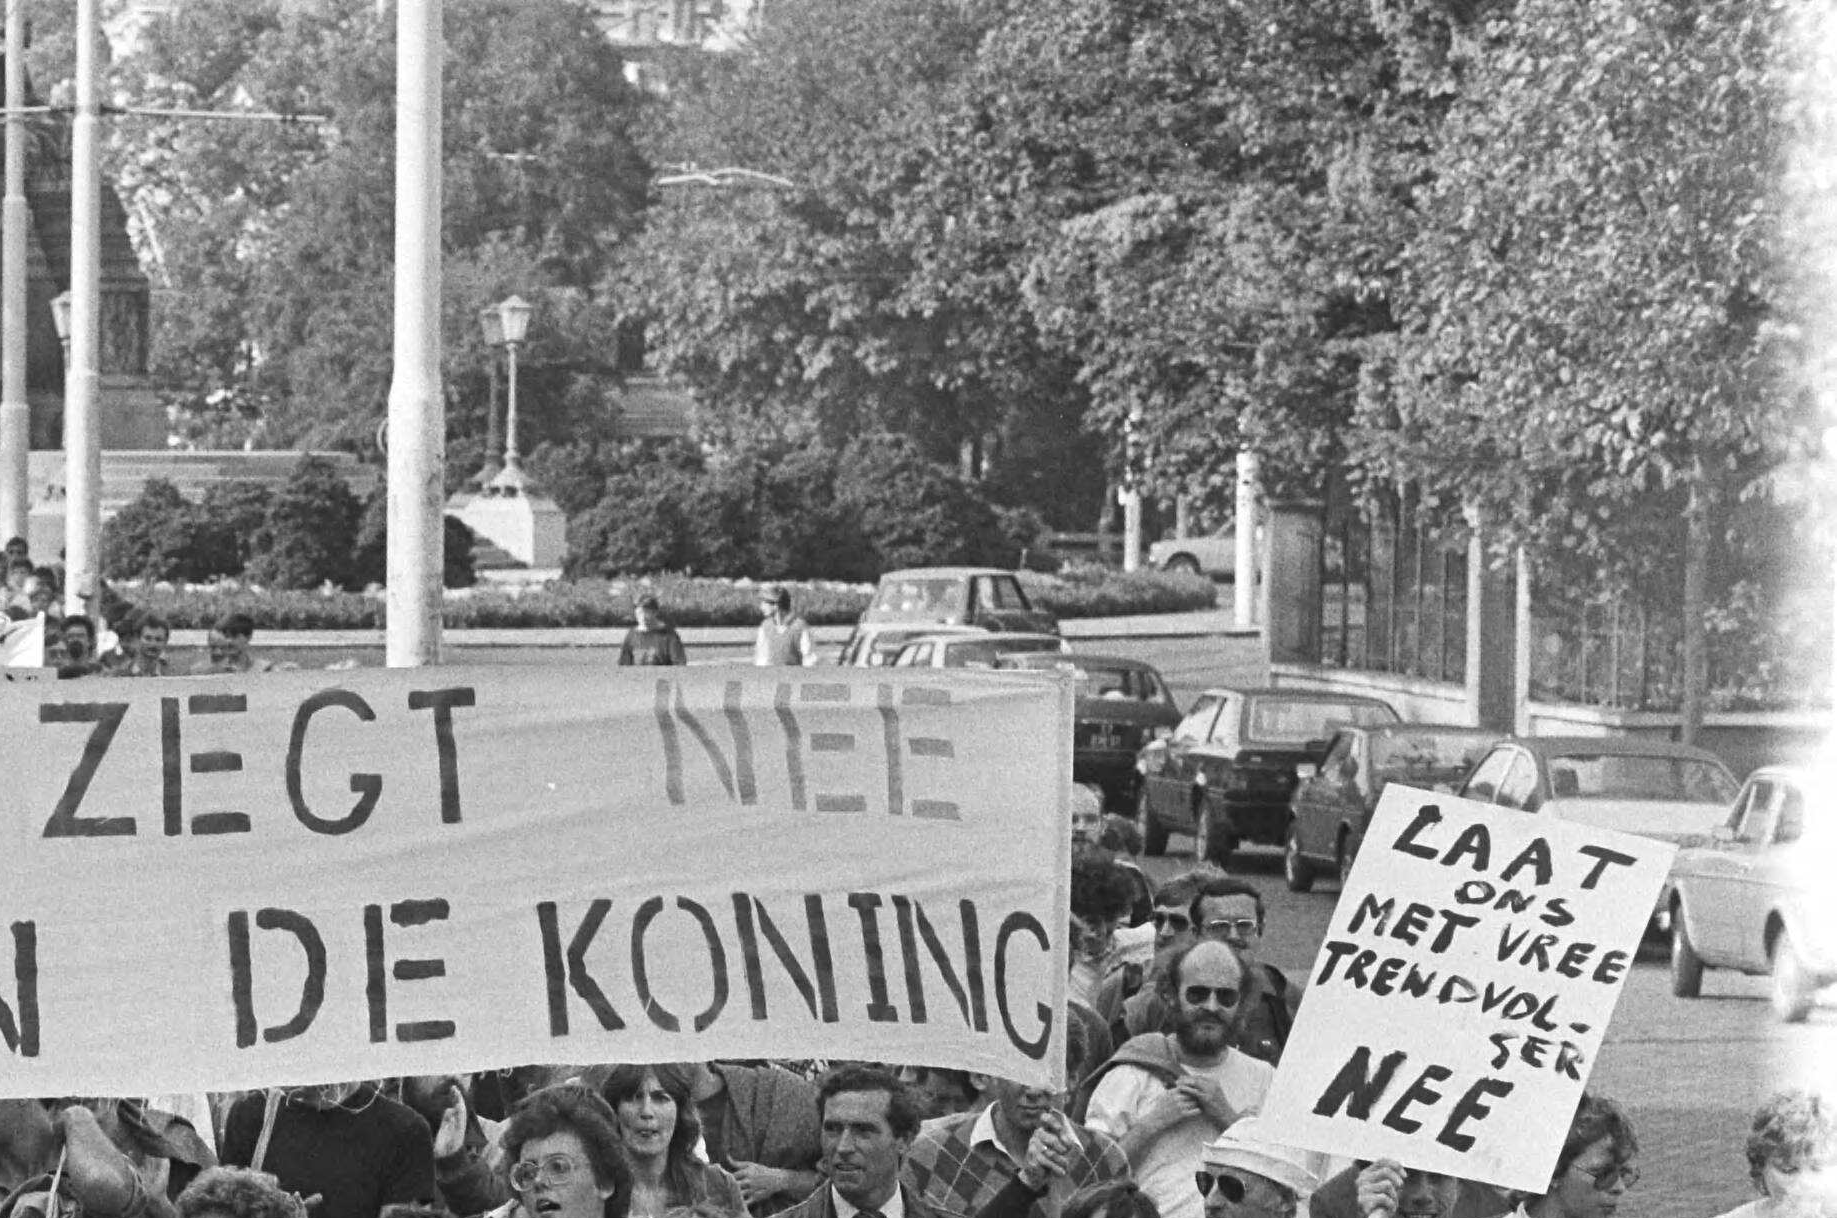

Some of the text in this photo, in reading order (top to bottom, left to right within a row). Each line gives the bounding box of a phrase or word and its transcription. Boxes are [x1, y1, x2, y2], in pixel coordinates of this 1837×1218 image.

[39, 686, 476, 839] ZEGT
[653, 677, 962, 822] NEE
[1391, 804, 1638, 890] LAAT
[1347, 892, 1627, 985] MET VREE
[1454, 880, 1575, 928] ONS
[227, 897, 457, 1049] DE
[536, 891, 1054, 1061] KONING
[1312, 1045, 1515, 1154] NEE
[1489, 1032, 1585, 1081] SER
